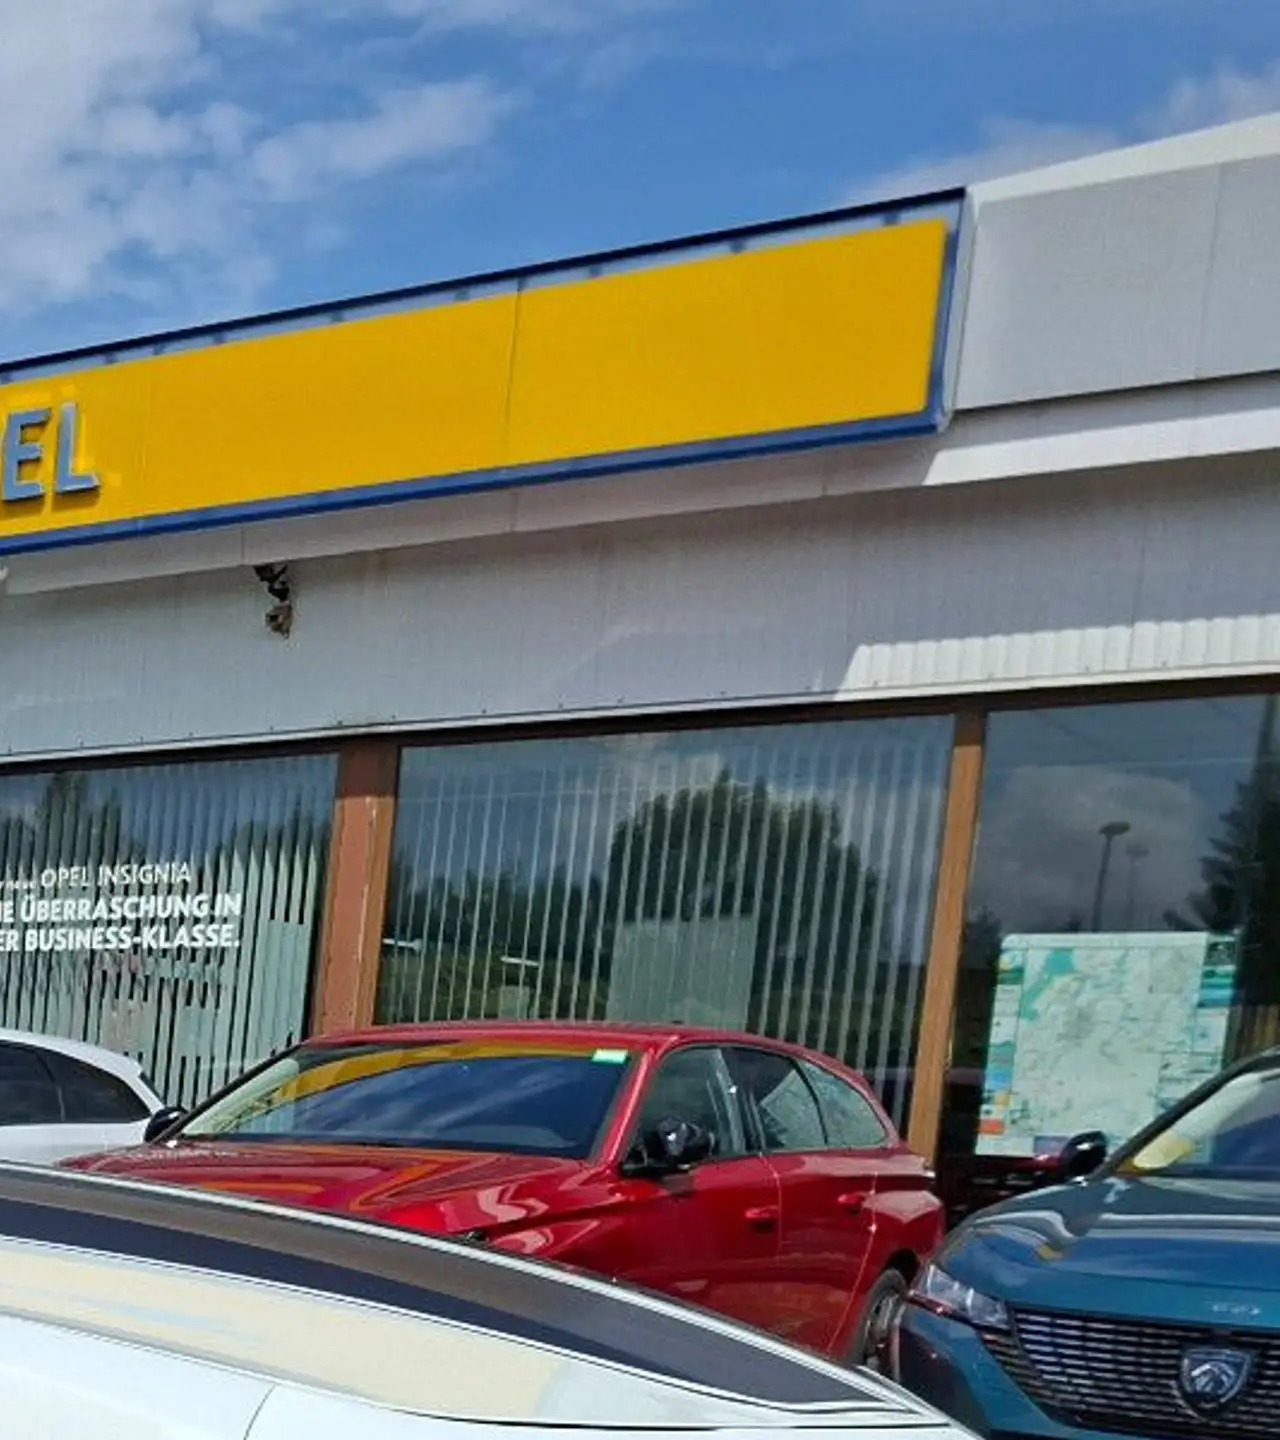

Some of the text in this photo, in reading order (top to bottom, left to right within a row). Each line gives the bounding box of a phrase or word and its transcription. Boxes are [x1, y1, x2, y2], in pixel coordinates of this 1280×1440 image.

[41, 867, 90, 888] OPEL
[98, 861, 191, 886] INSIGNIA
[20, 893, 209, 923] ÜBERRASCHUNG
[215, 892, 241, 916] IN
[25, 924, 240, 951] BUSINESS-KLASSE.
